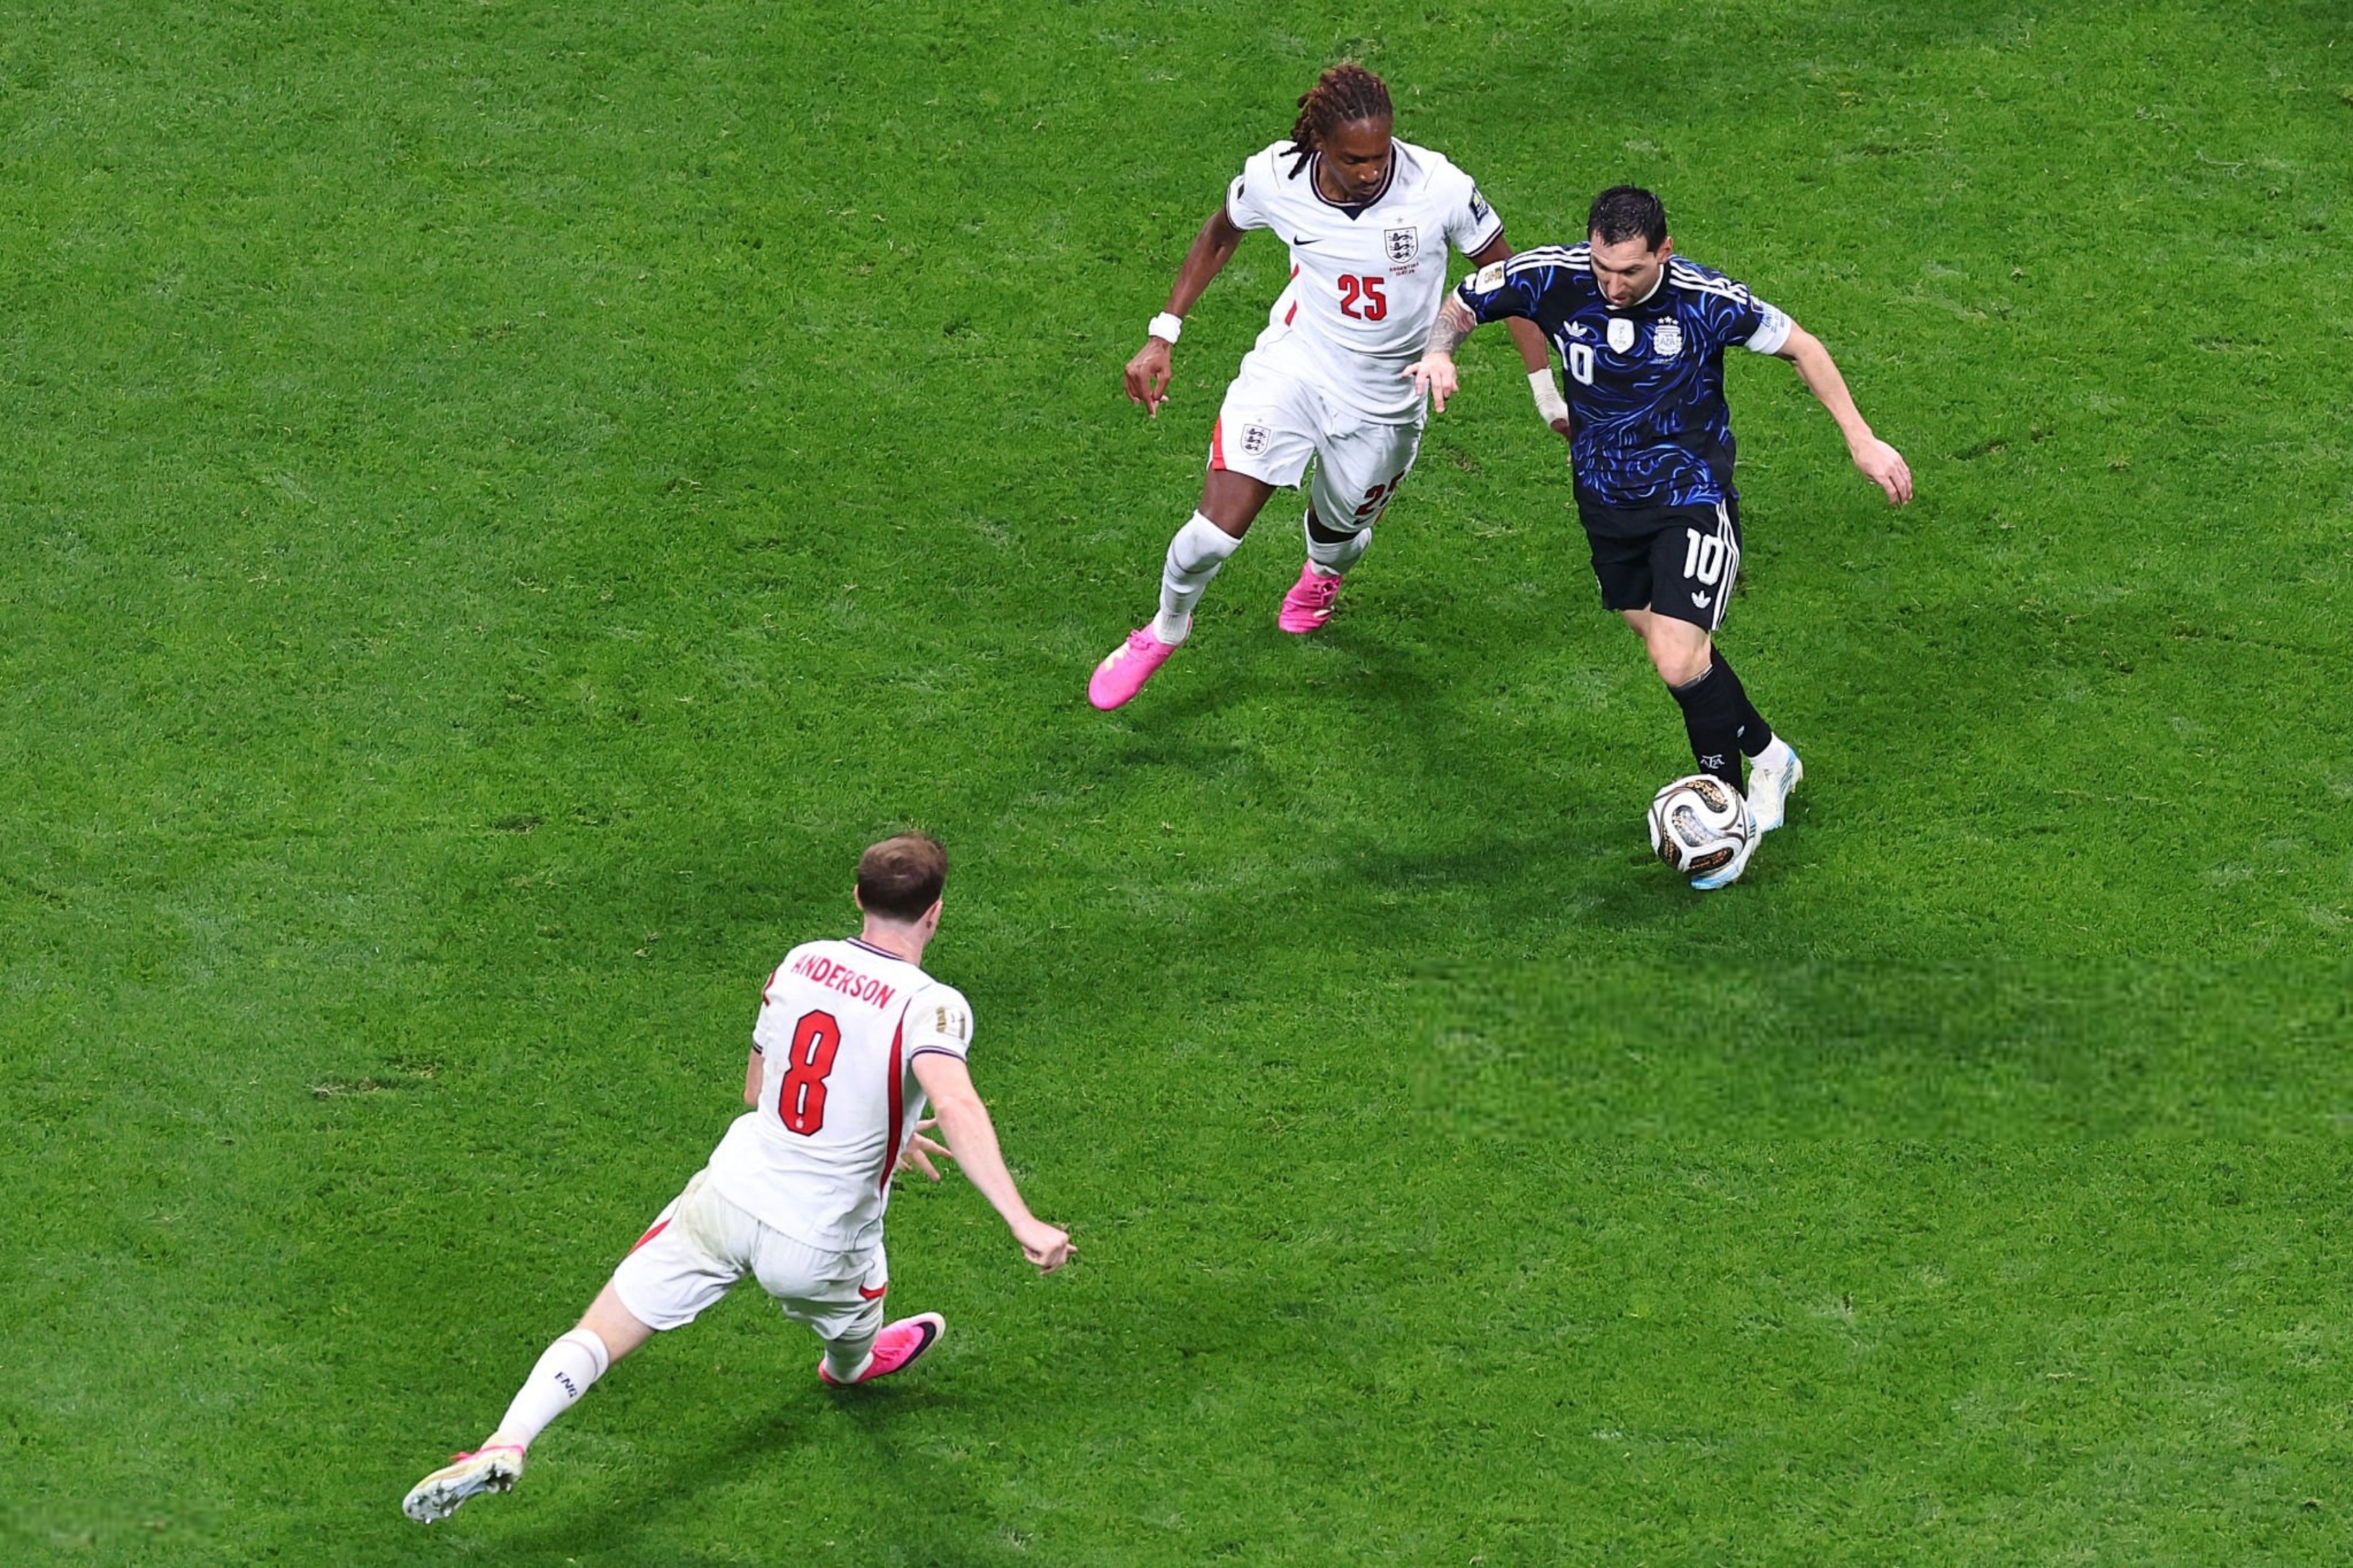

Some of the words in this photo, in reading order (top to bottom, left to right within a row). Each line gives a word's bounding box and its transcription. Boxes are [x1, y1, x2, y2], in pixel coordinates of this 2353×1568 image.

[1337, 274, 1387, 321] 25
[1553, 332, 1595, 386] 10
[1683, 527, 1726, 587] 10
[791, 953, 897, 1010] ANDERSON
[778, 1009, 842, 1137] 8
[554, 1371, 578, 1398] ENG
